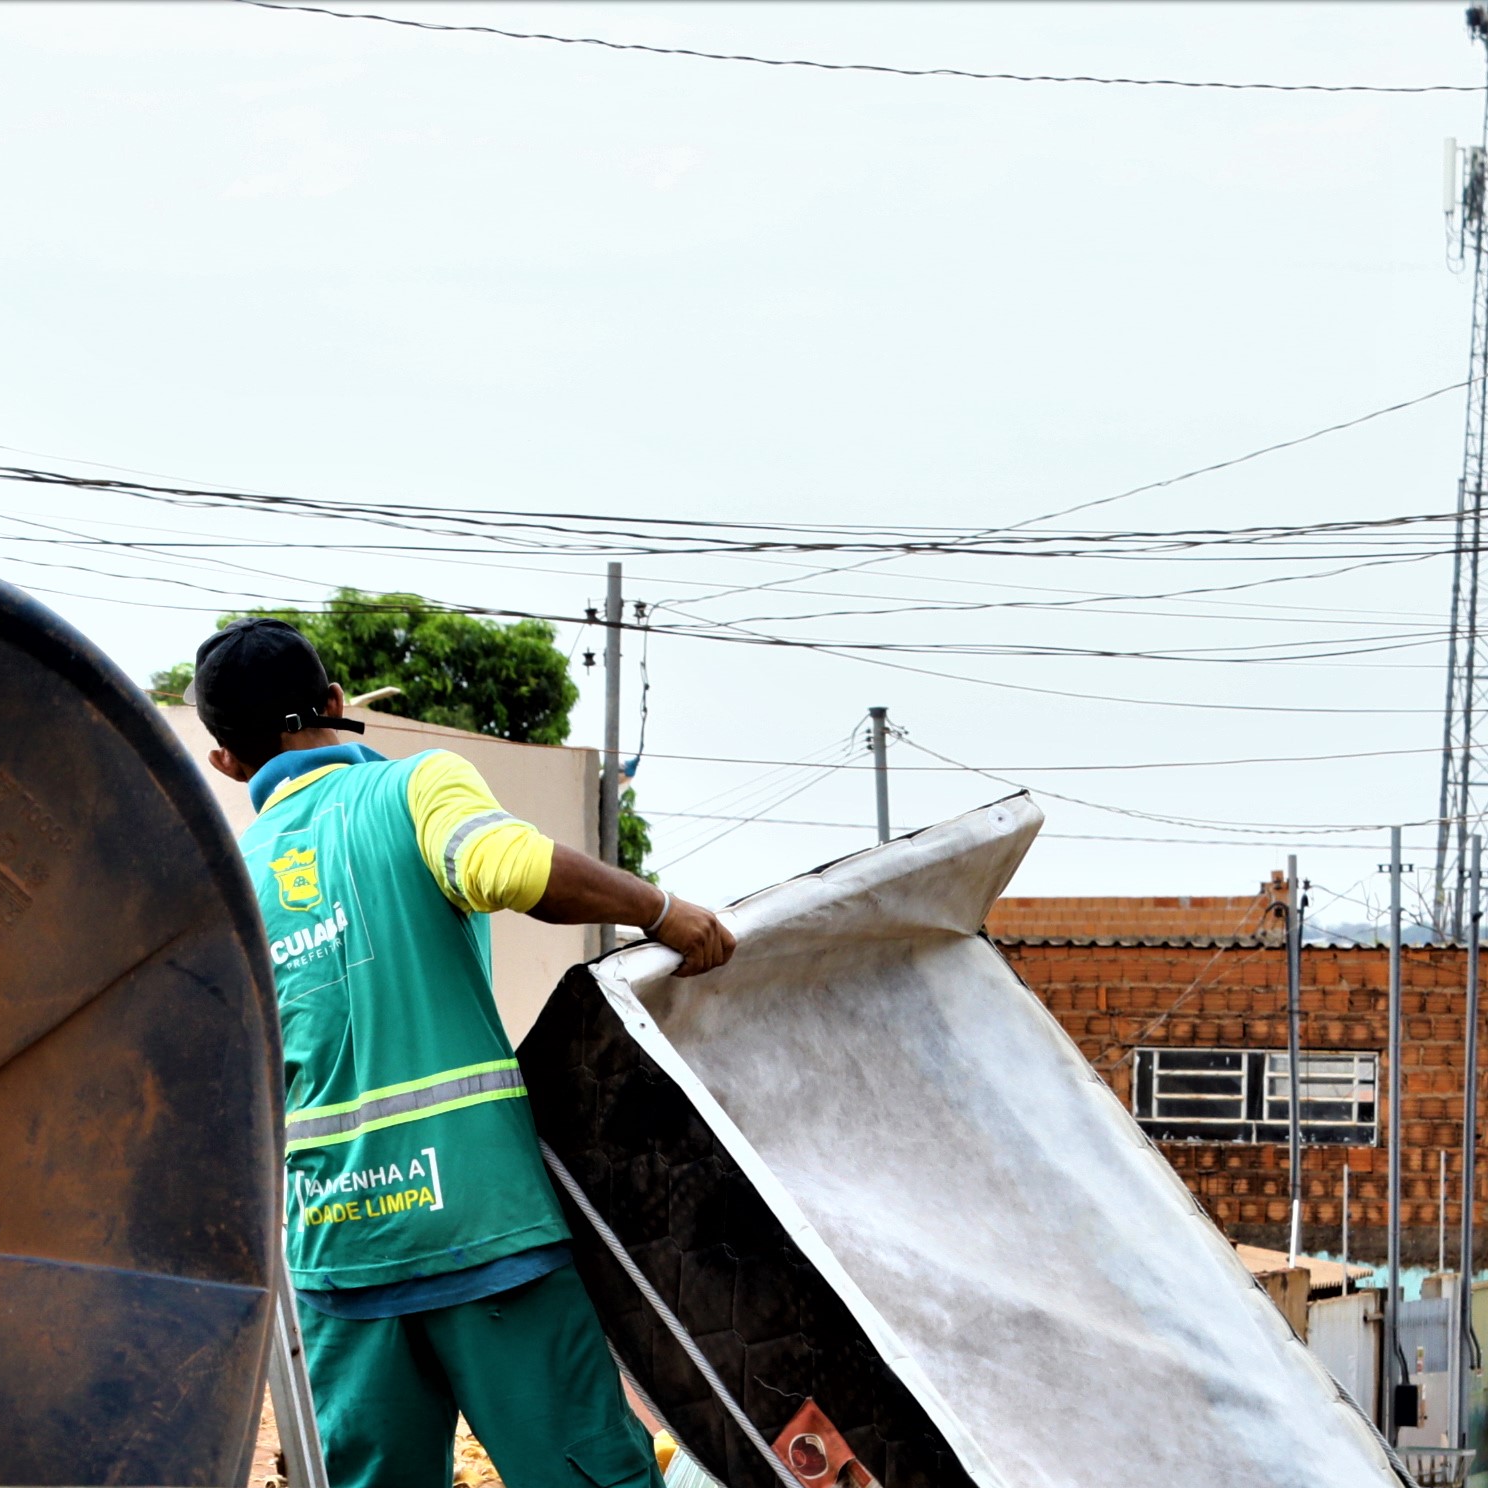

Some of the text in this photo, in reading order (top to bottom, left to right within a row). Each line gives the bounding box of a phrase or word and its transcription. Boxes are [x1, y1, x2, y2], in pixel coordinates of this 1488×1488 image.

[408, 1158, 426, 1180] A
[305, 1186, 435, 1226] IDADE LIMPA
